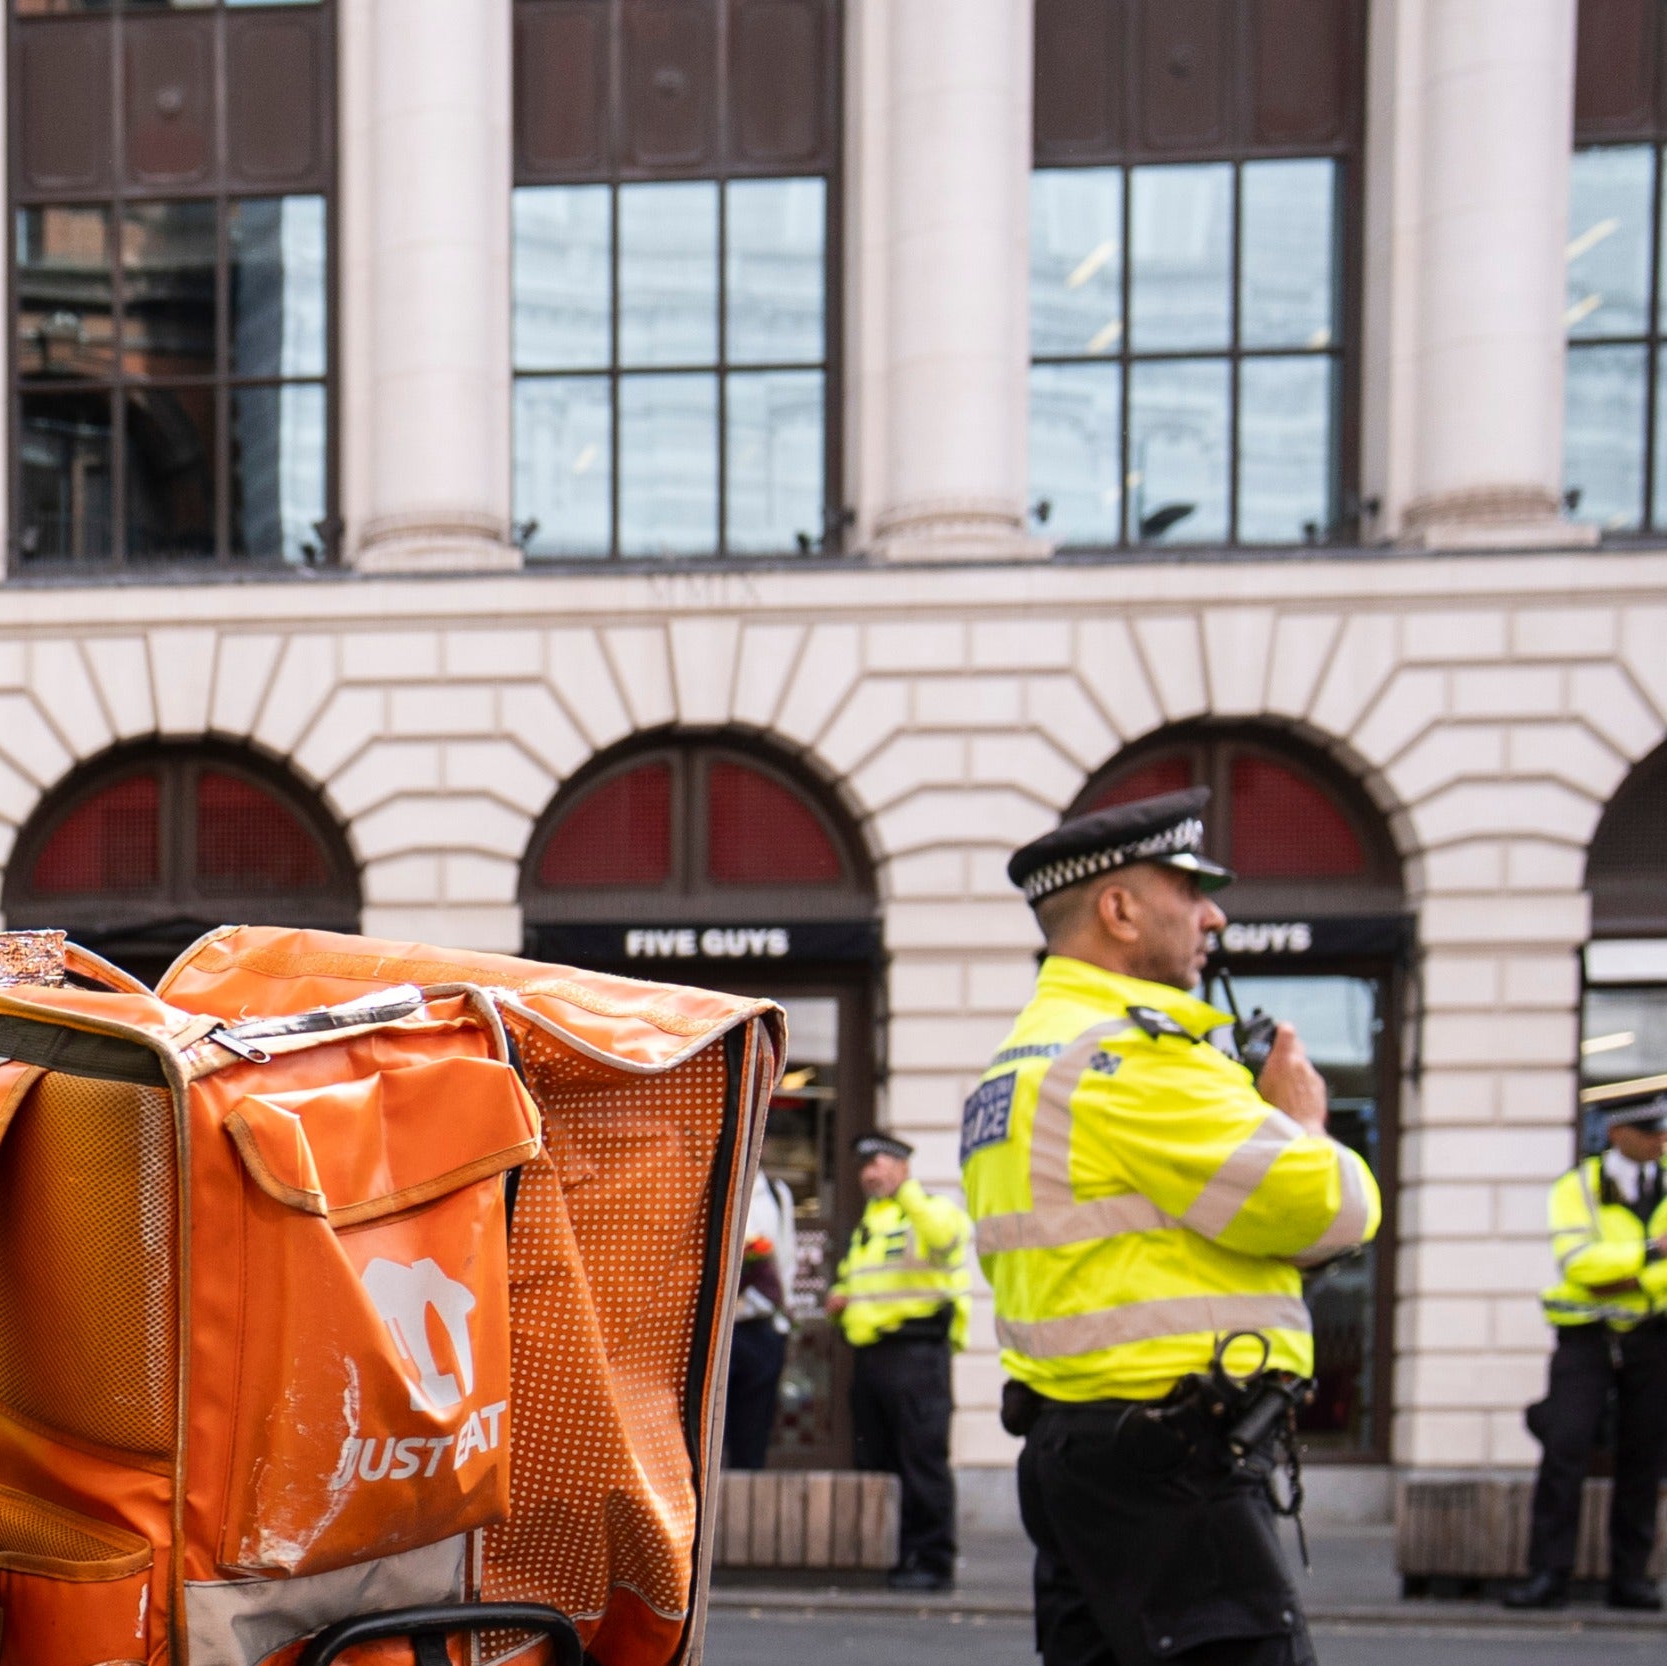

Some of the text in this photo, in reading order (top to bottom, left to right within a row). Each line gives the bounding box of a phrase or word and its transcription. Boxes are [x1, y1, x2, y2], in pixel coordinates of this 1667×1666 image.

[626, 928, 789, 957] FIVE GUYS
[328, 1400, 507, 1491] JUST EAT
